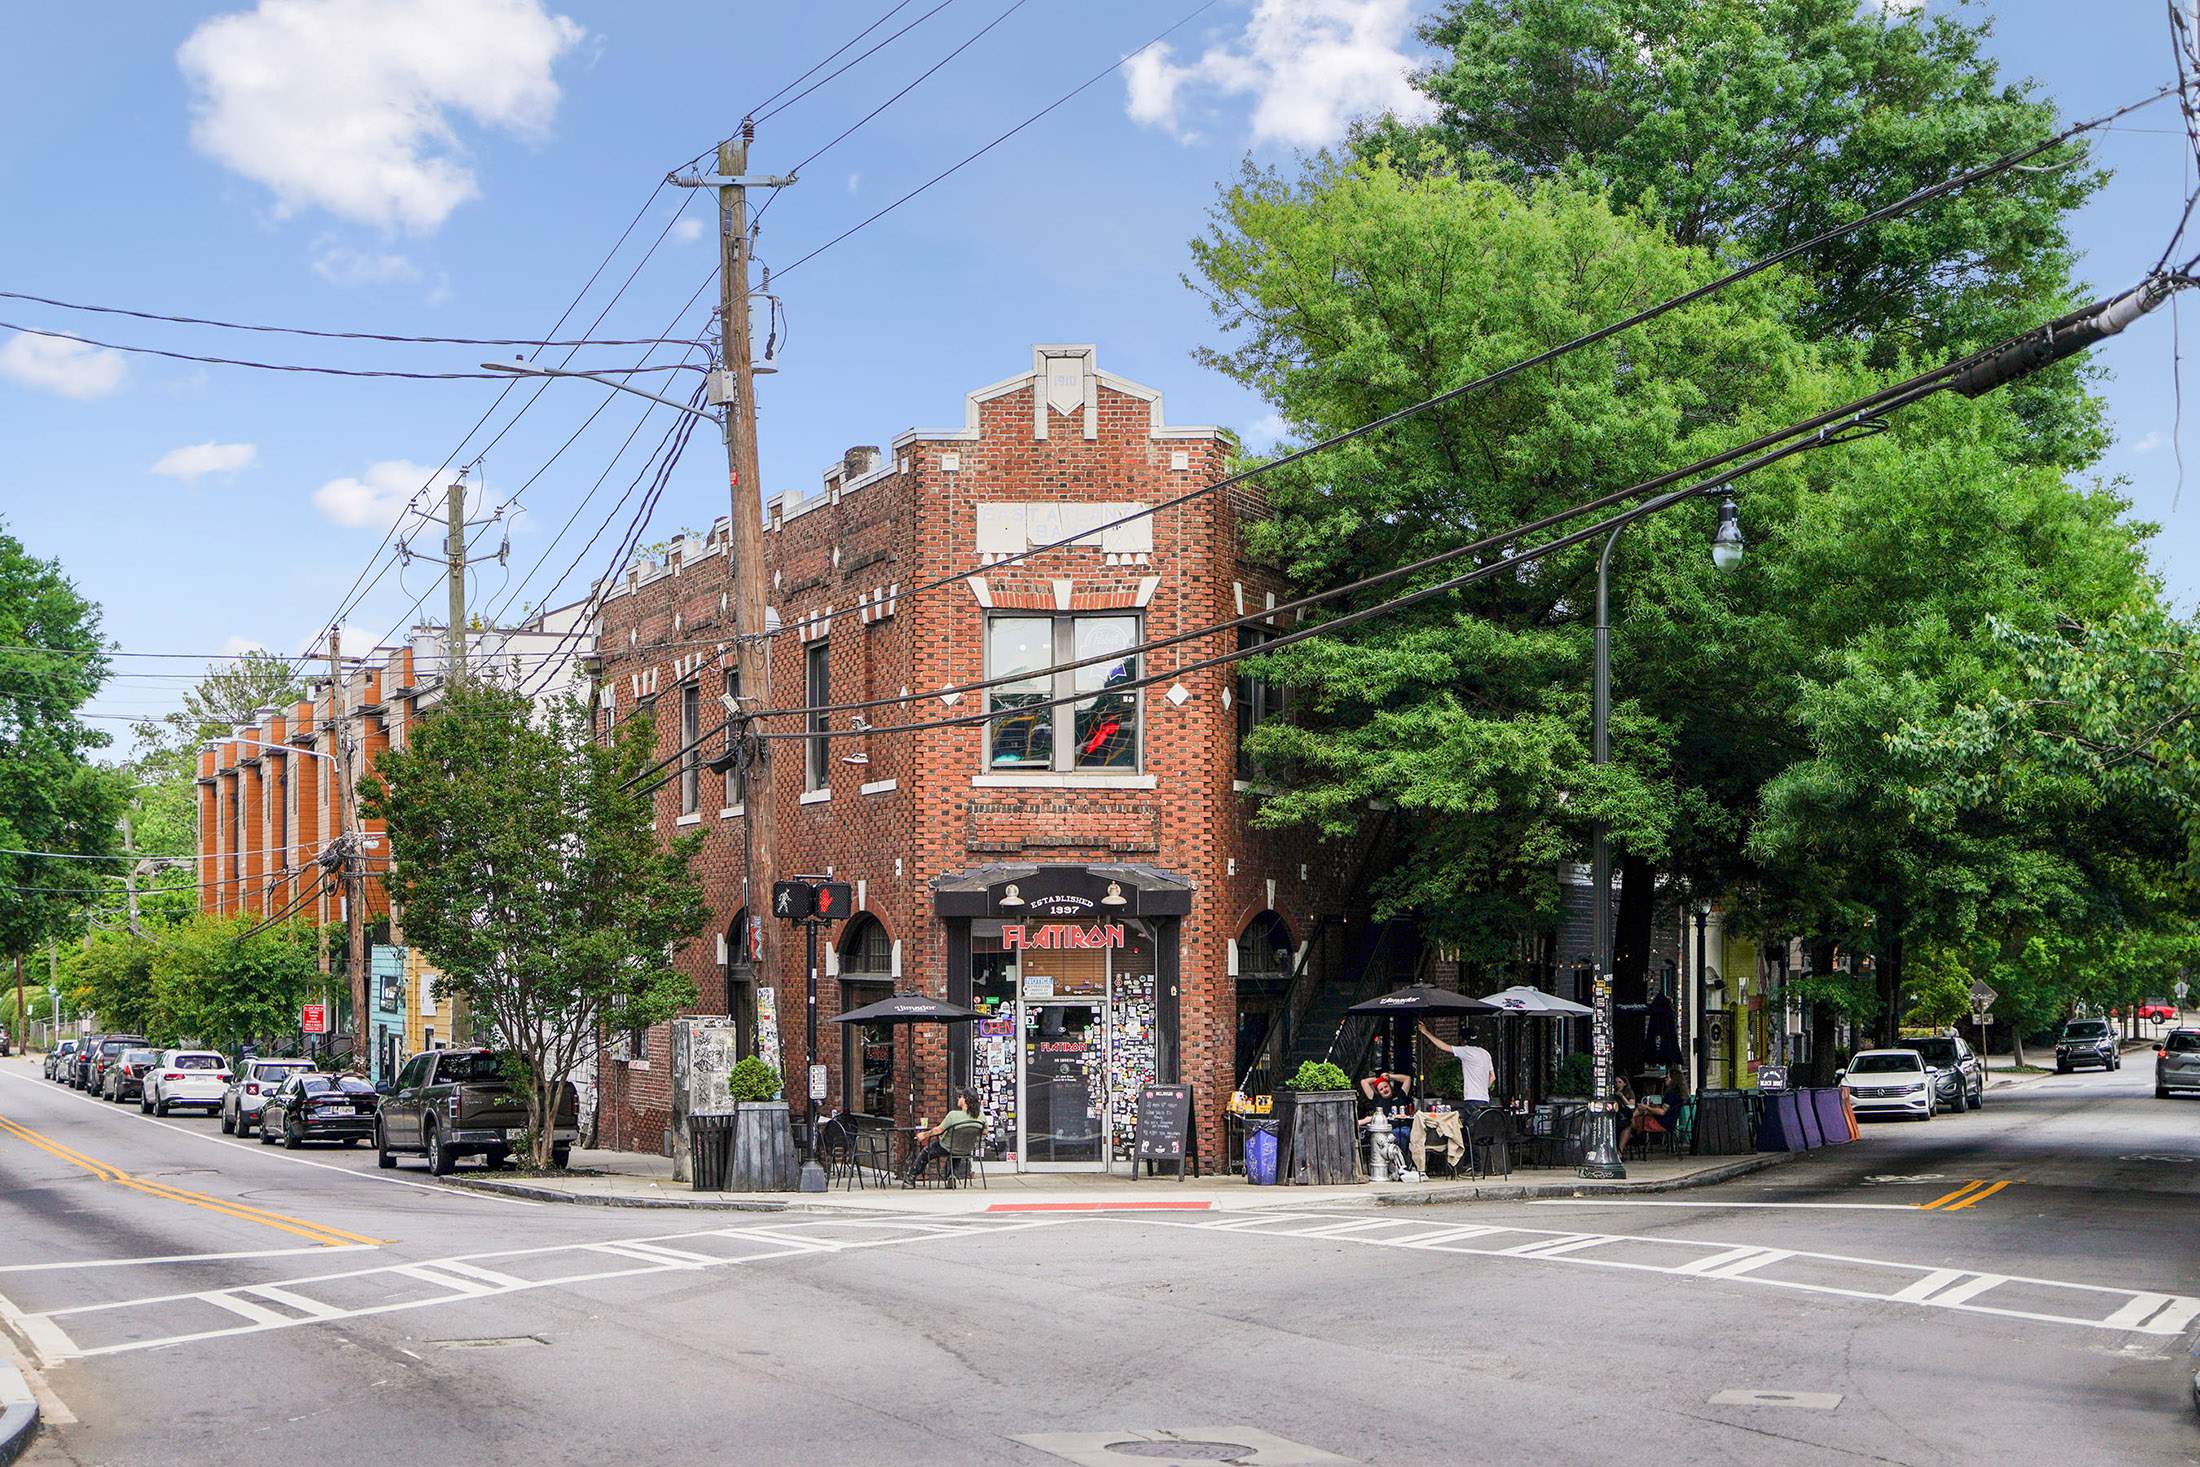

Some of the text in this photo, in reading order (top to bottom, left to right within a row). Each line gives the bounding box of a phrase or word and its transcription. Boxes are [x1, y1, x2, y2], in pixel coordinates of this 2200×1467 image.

[1054, 375, 1077, 387] 1910
[983, 507, 1039, 522] EAST
[1030, 895, 1094, 909] ESTABLISHED
[1050, 906, 1079, 915] 1997
[1002, 924, 1124, 949] FLATIRON
[982, 1020, 1013, 1035] OPEN
[1041, 1042, 1087, 1052] FLATIRON
